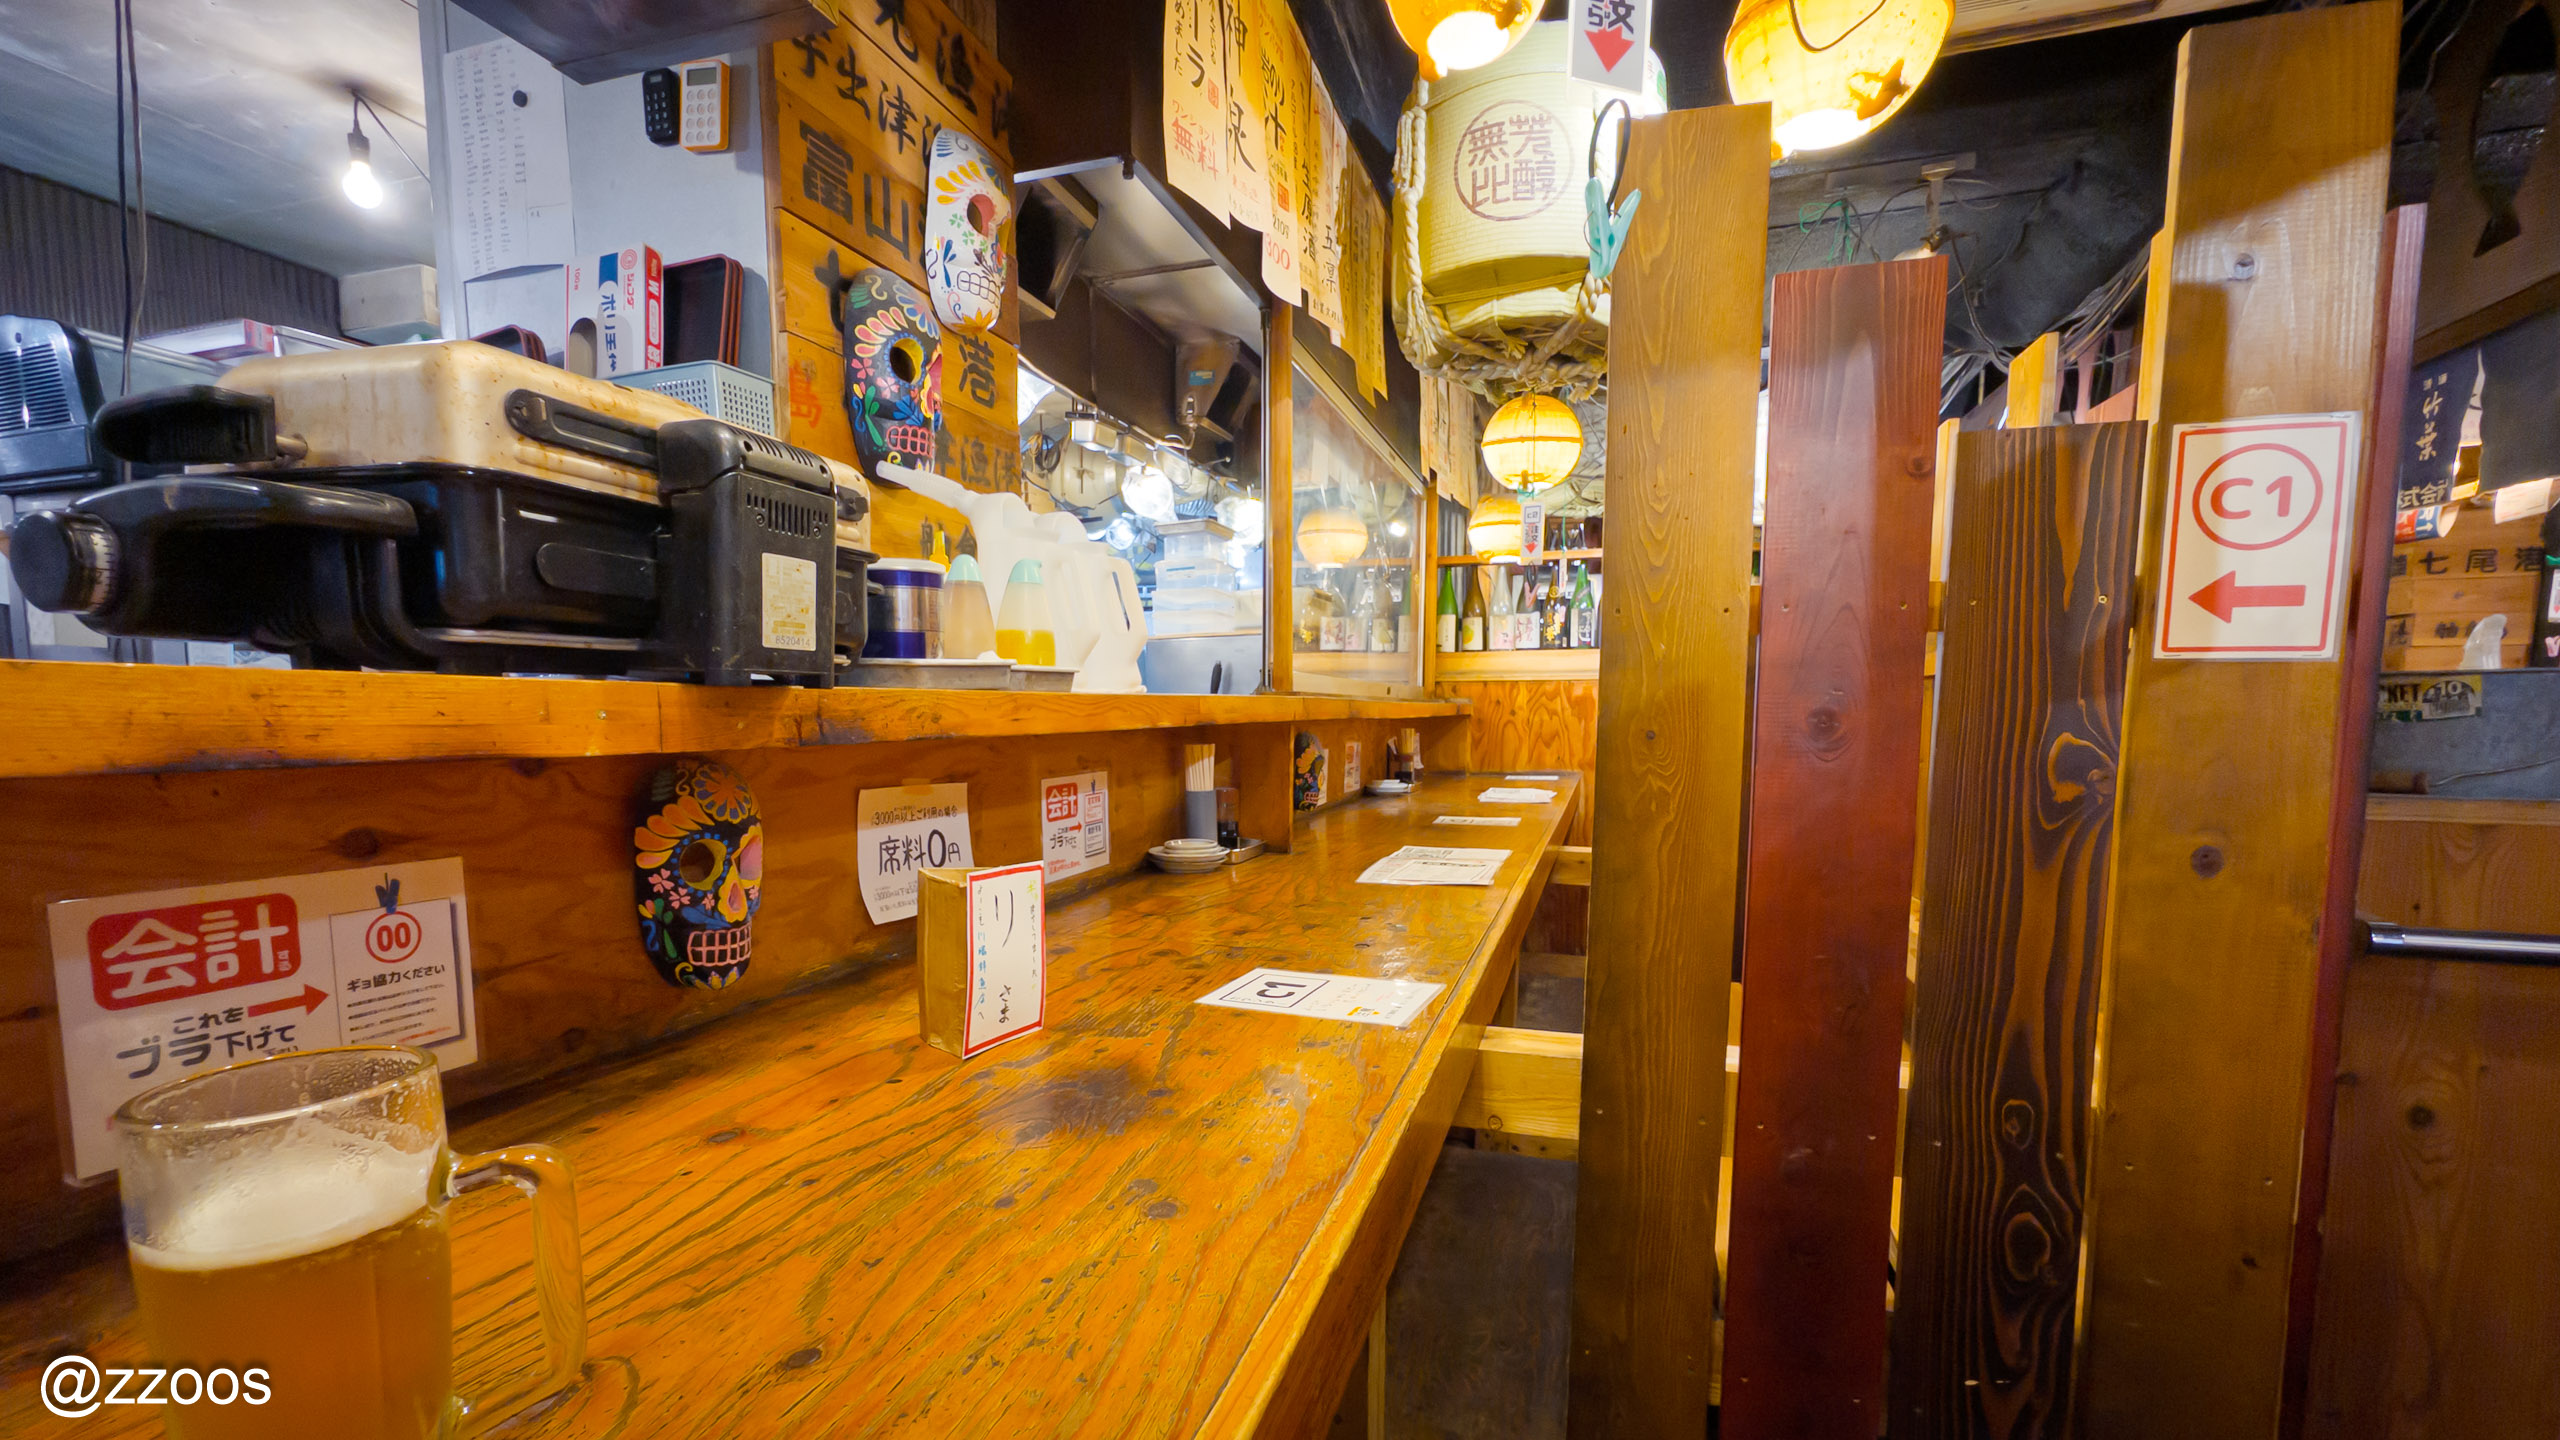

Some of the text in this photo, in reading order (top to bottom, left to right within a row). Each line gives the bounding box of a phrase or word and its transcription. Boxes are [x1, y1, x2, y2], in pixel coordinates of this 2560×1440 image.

[792, 31, 942, 169] 宇出津
[1171, 116, 1219, 182] 無料
[1265, 232, 1291, 271] 300
[2209, 474, 2294, 520] C1
[2418, 545, 2544, 575] 七尾港
[1047, 786, 1077, 820] 会計
[878, 828, 962, 876] 席料0円
[101, 902, 290, 1000] 会計
[346, 963, 446, 993] ギョ協力ください
[1256, 980, 1308, 1000] C1
[172, 1006, 246, 1035] これを
[116, 1023, 297, 1080] ブラ下げて
